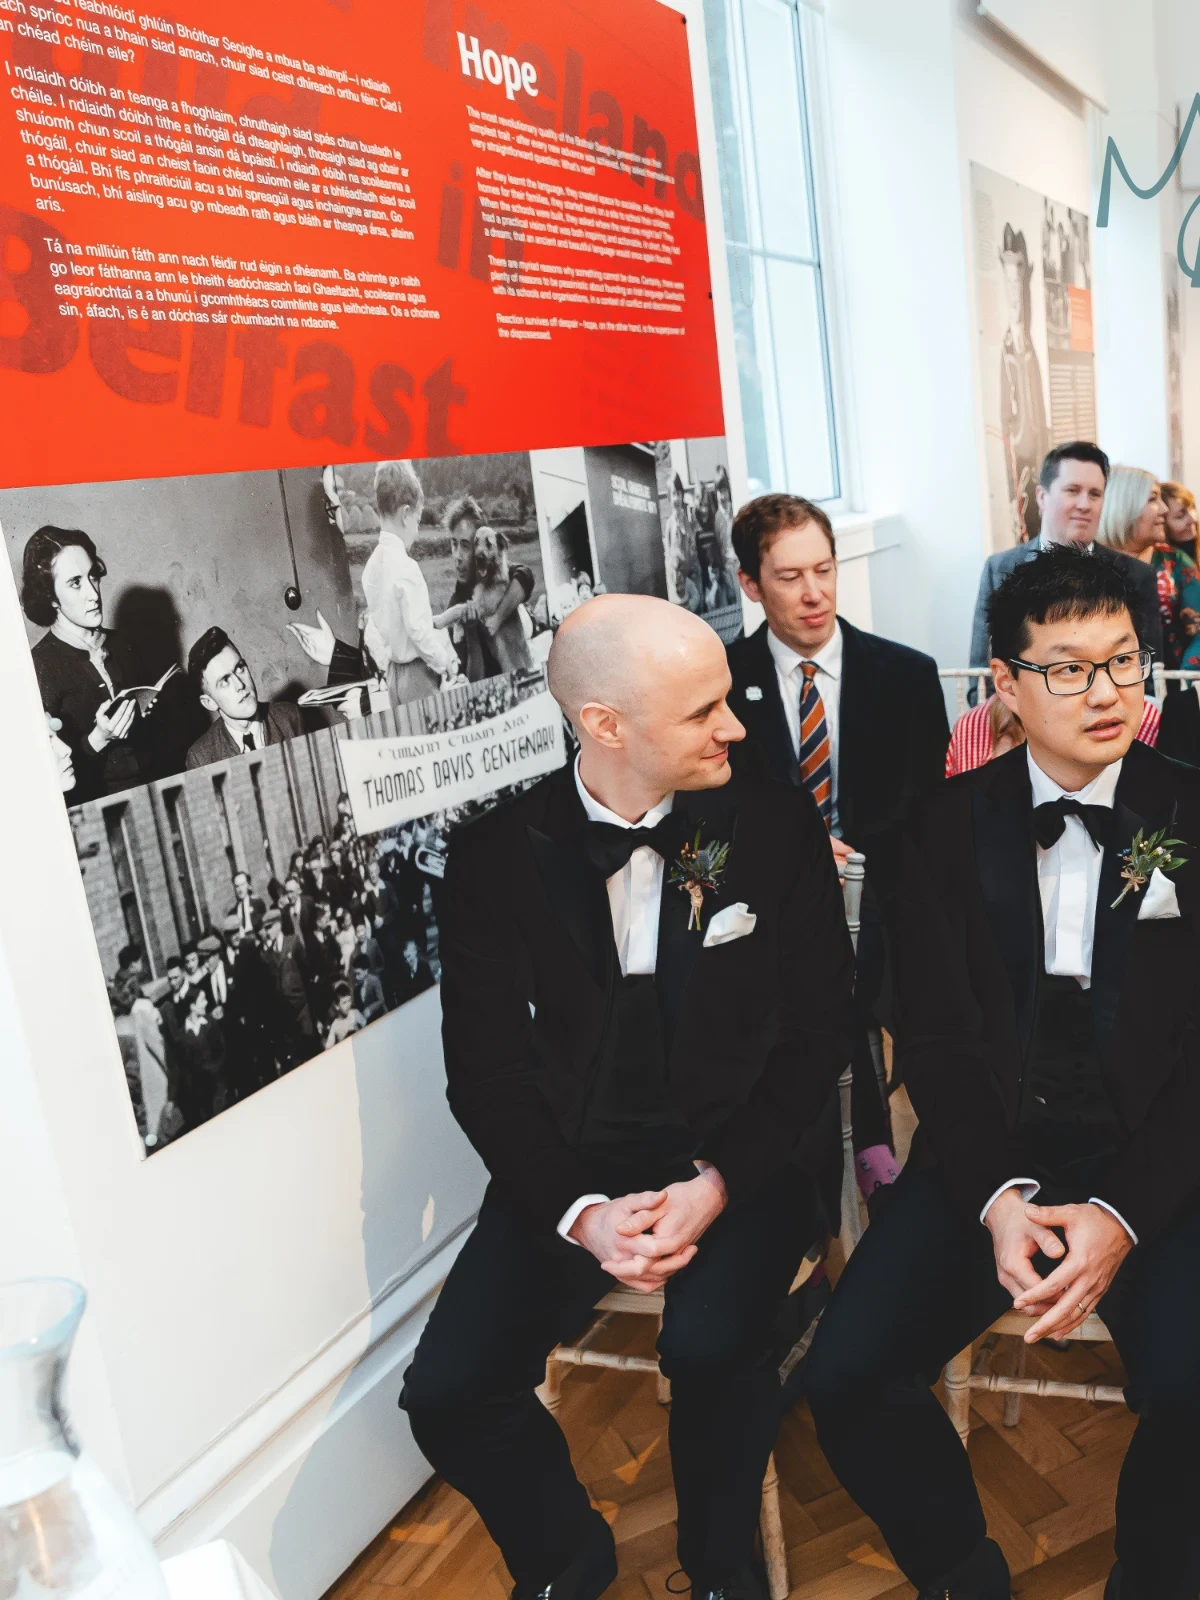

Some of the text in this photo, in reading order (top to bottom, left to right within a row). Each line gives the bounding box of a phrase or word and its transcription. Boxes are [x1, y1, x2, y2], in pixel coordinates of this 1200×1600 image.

[18, 22, 61, 44] chéad
[64, 35, 104, 55] chéim
[107, 46, 135, 63] eile?
[30, 5, 73, 27] sprioc
[76, 18, 101, 34] nua
[104, 26, 112, 38] a
[114, 25, 149, 47] bhain
[151, 38, 176, 54] siad
[178, 46, 218, 67] amach,
[221, 56, 246, 72] chuir
[249, 64, 270, 79] siad
[139, 15, 175, 35] ghlúin
[176, 23, 219, 47] Bhóthar
[222, 37, 264, 59] Seoighe
[266, 52, 273, 62] a
[456, 31, 538, 100] Hope
[5, 61, 10, 75] I
[14, 66, 66, 87] ndiaidh
[69, 77, 106, 96] dóibh
[110, 88, 125, 100] an
[128, 90, 169, 111] teanga
[171, 102, 179, 112] a
[181, 101, 237, 126] fhoghlaim,
[239, 115, 291, 138] chruthaigh
[11, 85, 56, 106] chéile.
[60, 94, 65, 108] I
[69, 99, 116, 118] ndiaidh
[119, 108, 153, 126] dóibh
[155, 115, 181, 132] tithe
[184, 124, 192, 134] a
[193, 123, 230, 142] thógáil
[248, 135, 306, 158] dteaghlaigh,
[16, 109, 75, 131] shuíomh
[78, 120, 110, 137] chun
[113, 129, 141, 143] scoil
[144, 135, 153, 146] a
[154, 134, 193, 154] thógáil
[196, 144, 224, 158] ansin
[20, 130, 72, 153] thógáil,
[75, 140, 107, 157] chuir
[110, 146, 136, 162] siad
[140, 154, 154, 165] an
[157, 155, 191, 171] cheist
[193, 160, 220, 176] faoin
[26, 154, 35, 166] a
[38, 154, 88, 175] thógáil.
[91, 162, 113, 178] Bhí
[115, 166, 131, 181] fís
[133, 170, 192, 190] phraiticiúil
[195, 182, 215, 194] acu
[217, 185, 225, 195] a
[30, 173, 100, 198] bunúsach,
[102, 184, 123, 199] bhí
[126, 189, 164, 208] aisling
[167, 197, 187, 209] acu
[190, 200, 204, 213] go
[207, 201, 249, 217] mbeadh
[251, 208, 271, 220] rath
[36, 197, 65, 212] arís.
[43, 238, 63, 253] Tá
[66, 244, 83, 255] na
[86, 244, 129, 259] milliúin
[131, 247, 155, 262] fáth
[158, 253, 179, 264] ann
[182, 255, 209, 267] nach
[240, 260, 257, 272] rud
[50, 263, 67, 277] go
[70, 261, 95, 276] leor
[98, 264, 152, 281] fáthanna
[155, 272, 176, 282] ann
[178, 271, 189, 284] le
[191, 272, 225, 287] bheith
[55, 284, 132, 299] eagraíochtaí
[135, 290, 143, 300] a
[146, 290, 154, 301] a
[156, 288, 192, 303] bhunú
[194, 291, 198, 303] i
[59, 302, 83, 318] sin,
[86, 303, 125, 320] áfach,
[127, 306, 138, 319] is
[141, 306, 149, 320] é
[152, 310, 166, 320] an
[169, 308, 210, 323] dóchas
[231, 312, 286, 326] chumhacht
[0, 205, 466, 457] Belfast
[363, 724, 556, 810] THOMAS DAVIS CENTENARY
